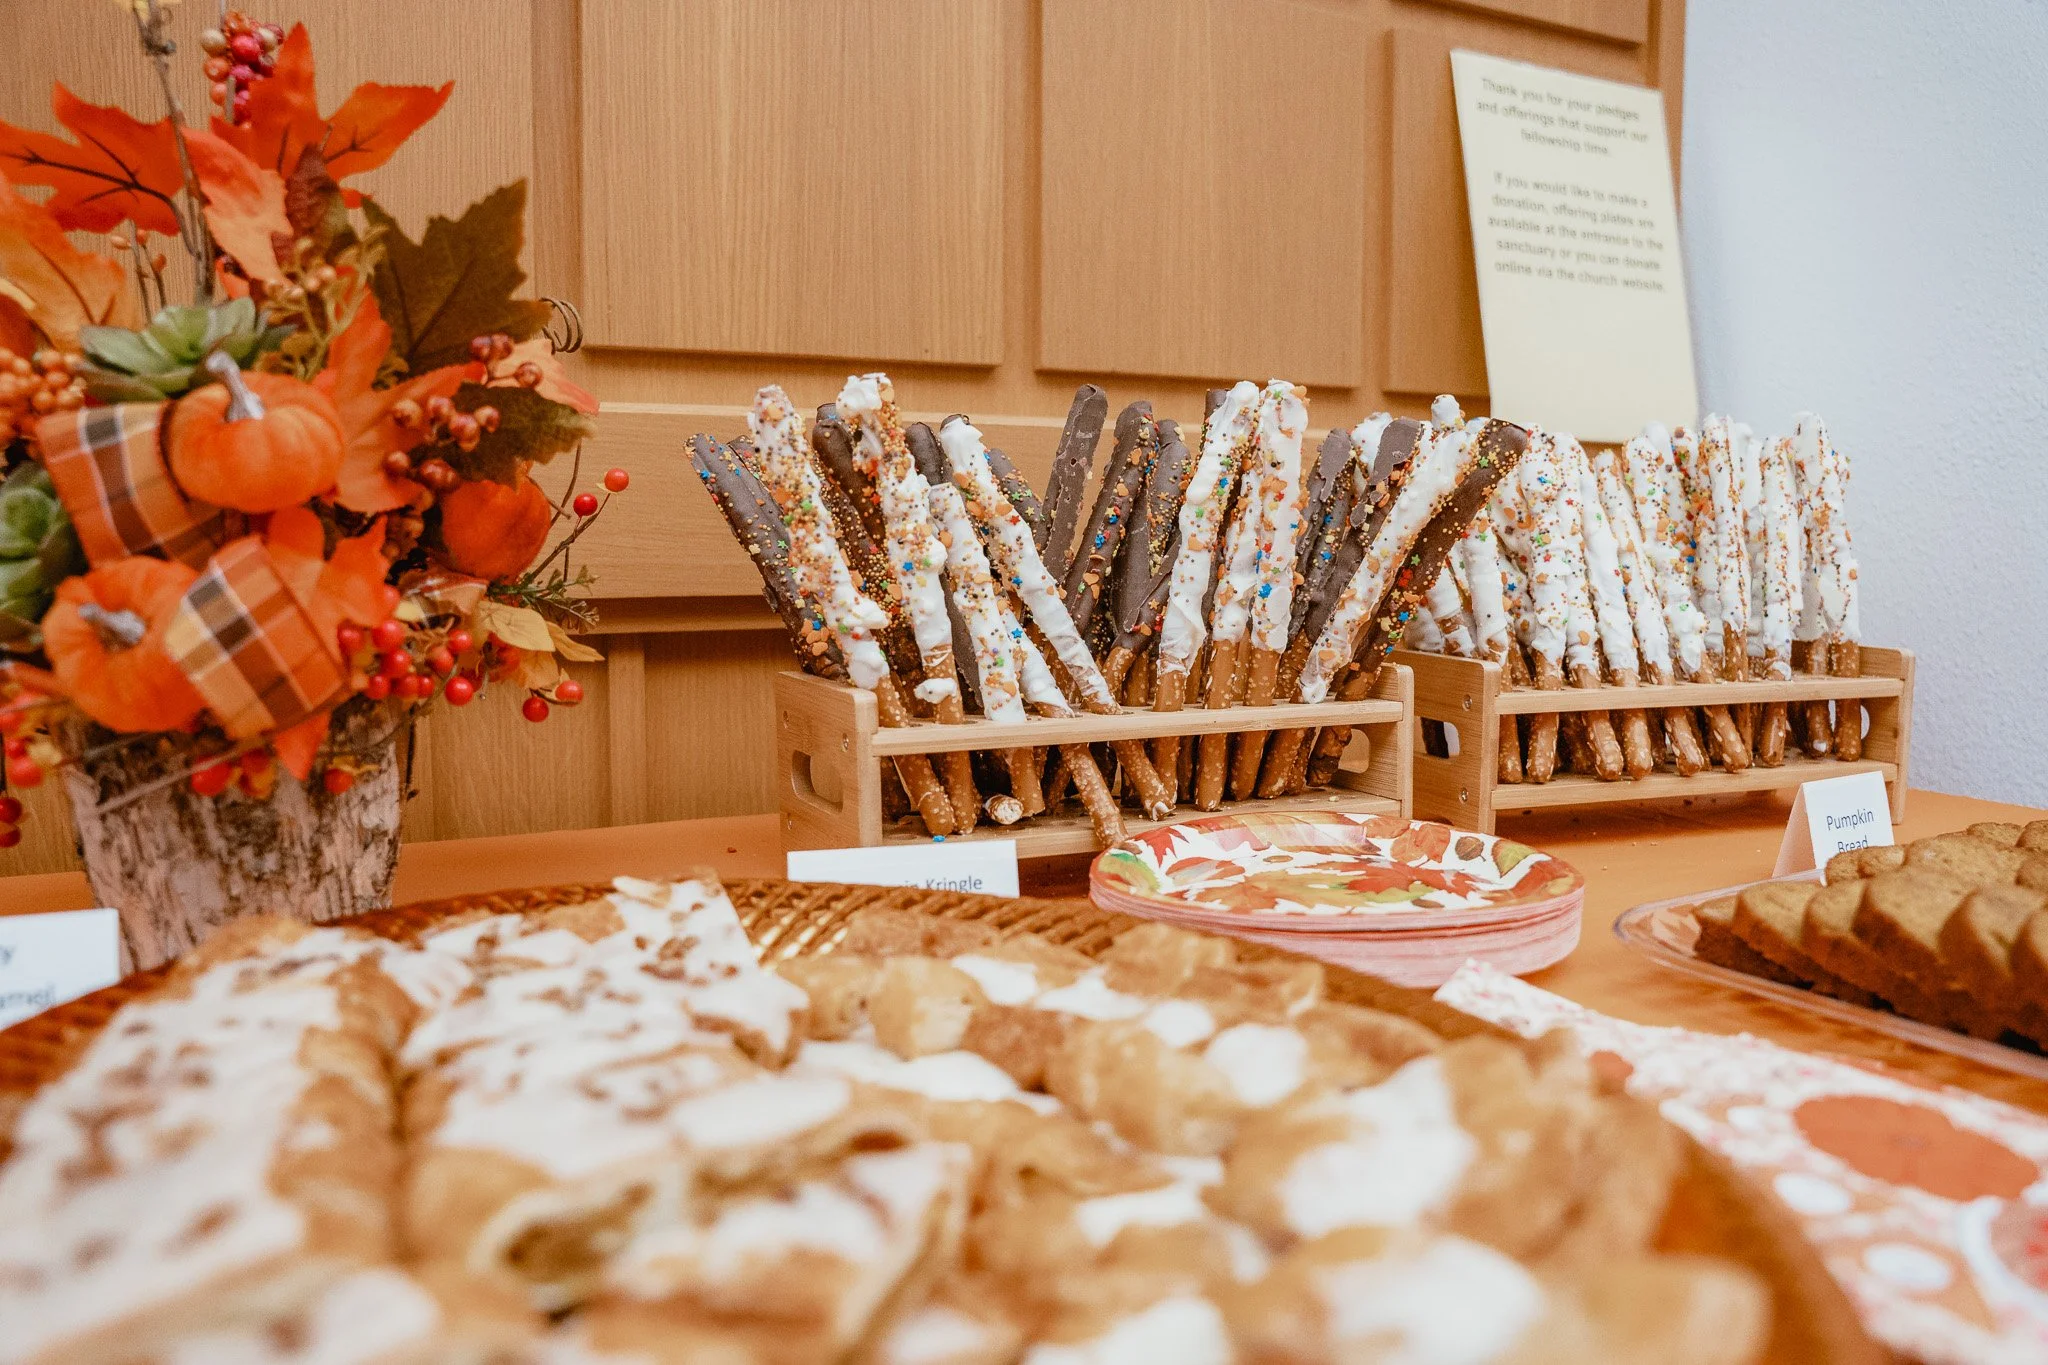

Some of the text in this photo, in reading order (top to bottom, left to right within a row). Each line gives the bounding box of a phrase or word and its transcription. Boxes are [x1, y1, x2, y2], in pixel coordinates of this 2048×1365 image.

[1481, 77, 1640, 121] Thank you for your pledges
[1477, 100, 1648, 143] and offerings that support our
[1521, 128, 1581, 153] fellowship
[1493, 171, 1503, 185] If
[1505, 175, 1528, 190] you
[1532, 179, 1567, 196] would
[1570, 184, 1591, 198] like
[1593, 188, 1604, 201] to
[1608, 191, 1638, 207] make
[1552, 202, 1597, 223] offering
[1600, 212, 1634, 228] plates
[1637, 218, 1655, 230] are
[1487, 214, 1664, 252] available at the entrance to the
[1496, 239, 1660, 271] sanctuary or you can donate
[1494, 259, 1532, 276] online
[1536, 265, 1552, 279] via
[1556, 267, 1575, 282] the
[1578, 270, 1618, 287] church
[1826, 808, 1875, 831] Pumpkin
[1837, 835, 1869, 853] Bread
[925, 876, 983, 893] Kringle
